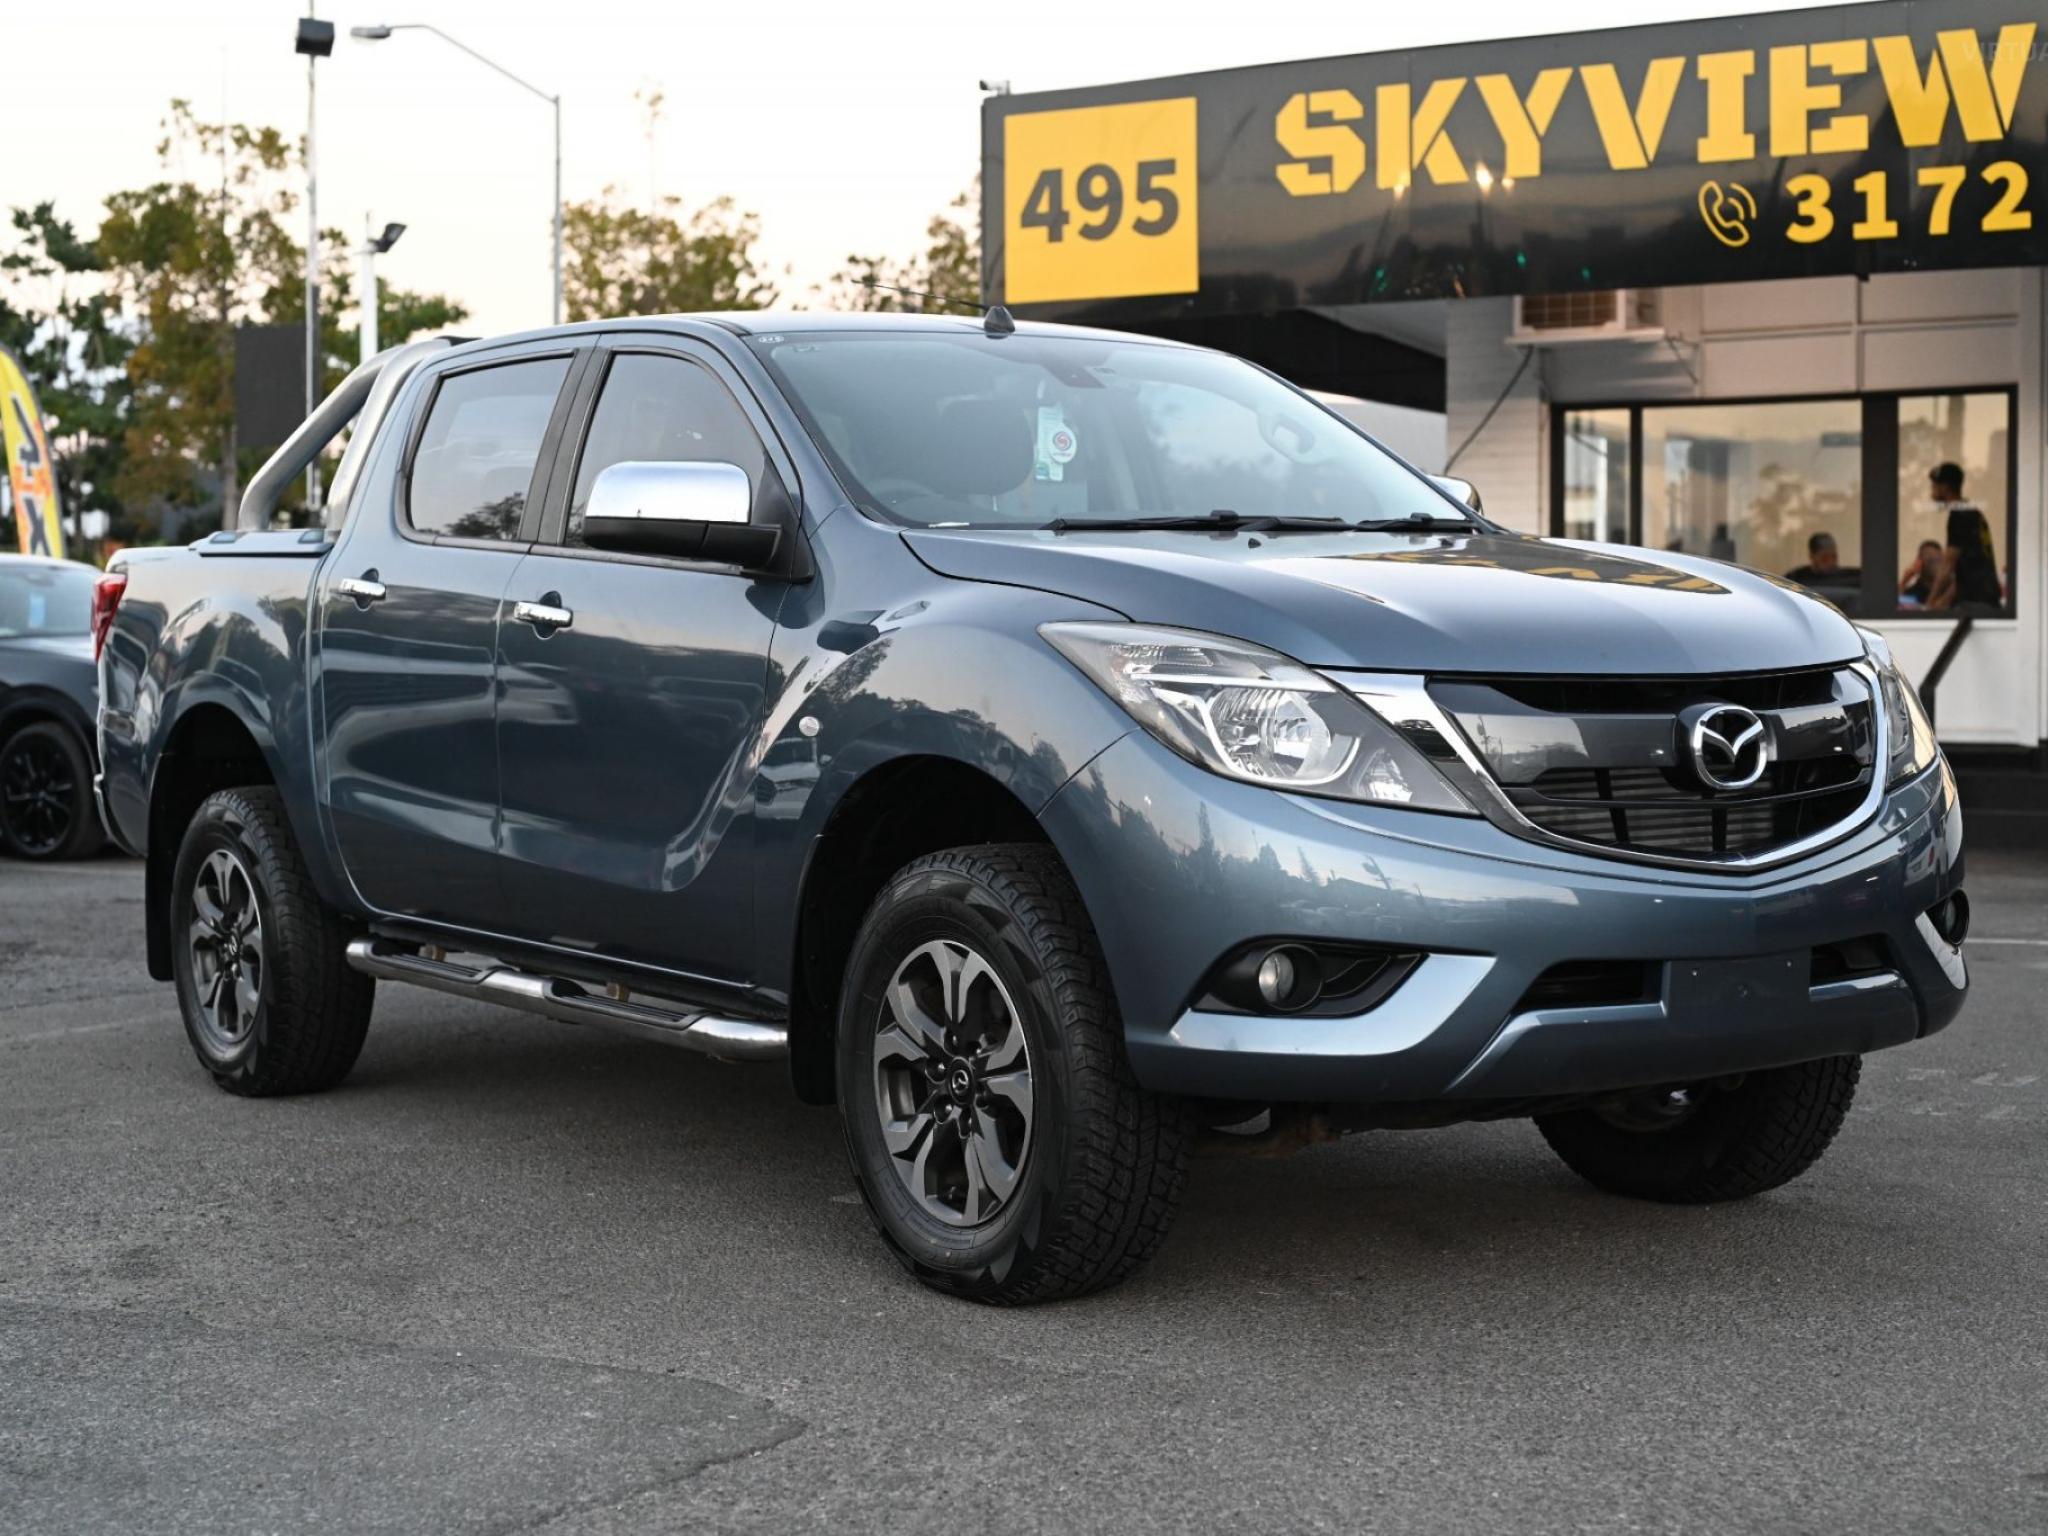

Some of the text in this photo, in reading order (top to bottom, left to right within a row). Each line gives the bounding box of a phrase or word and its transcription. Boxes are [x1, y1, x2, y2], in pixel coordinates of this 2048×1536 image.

[1275, 21, 2038, 198] SKYVIEW
[1021, 158, 1180, 243] 495
[1784, 160, 2033, 243] 3172
